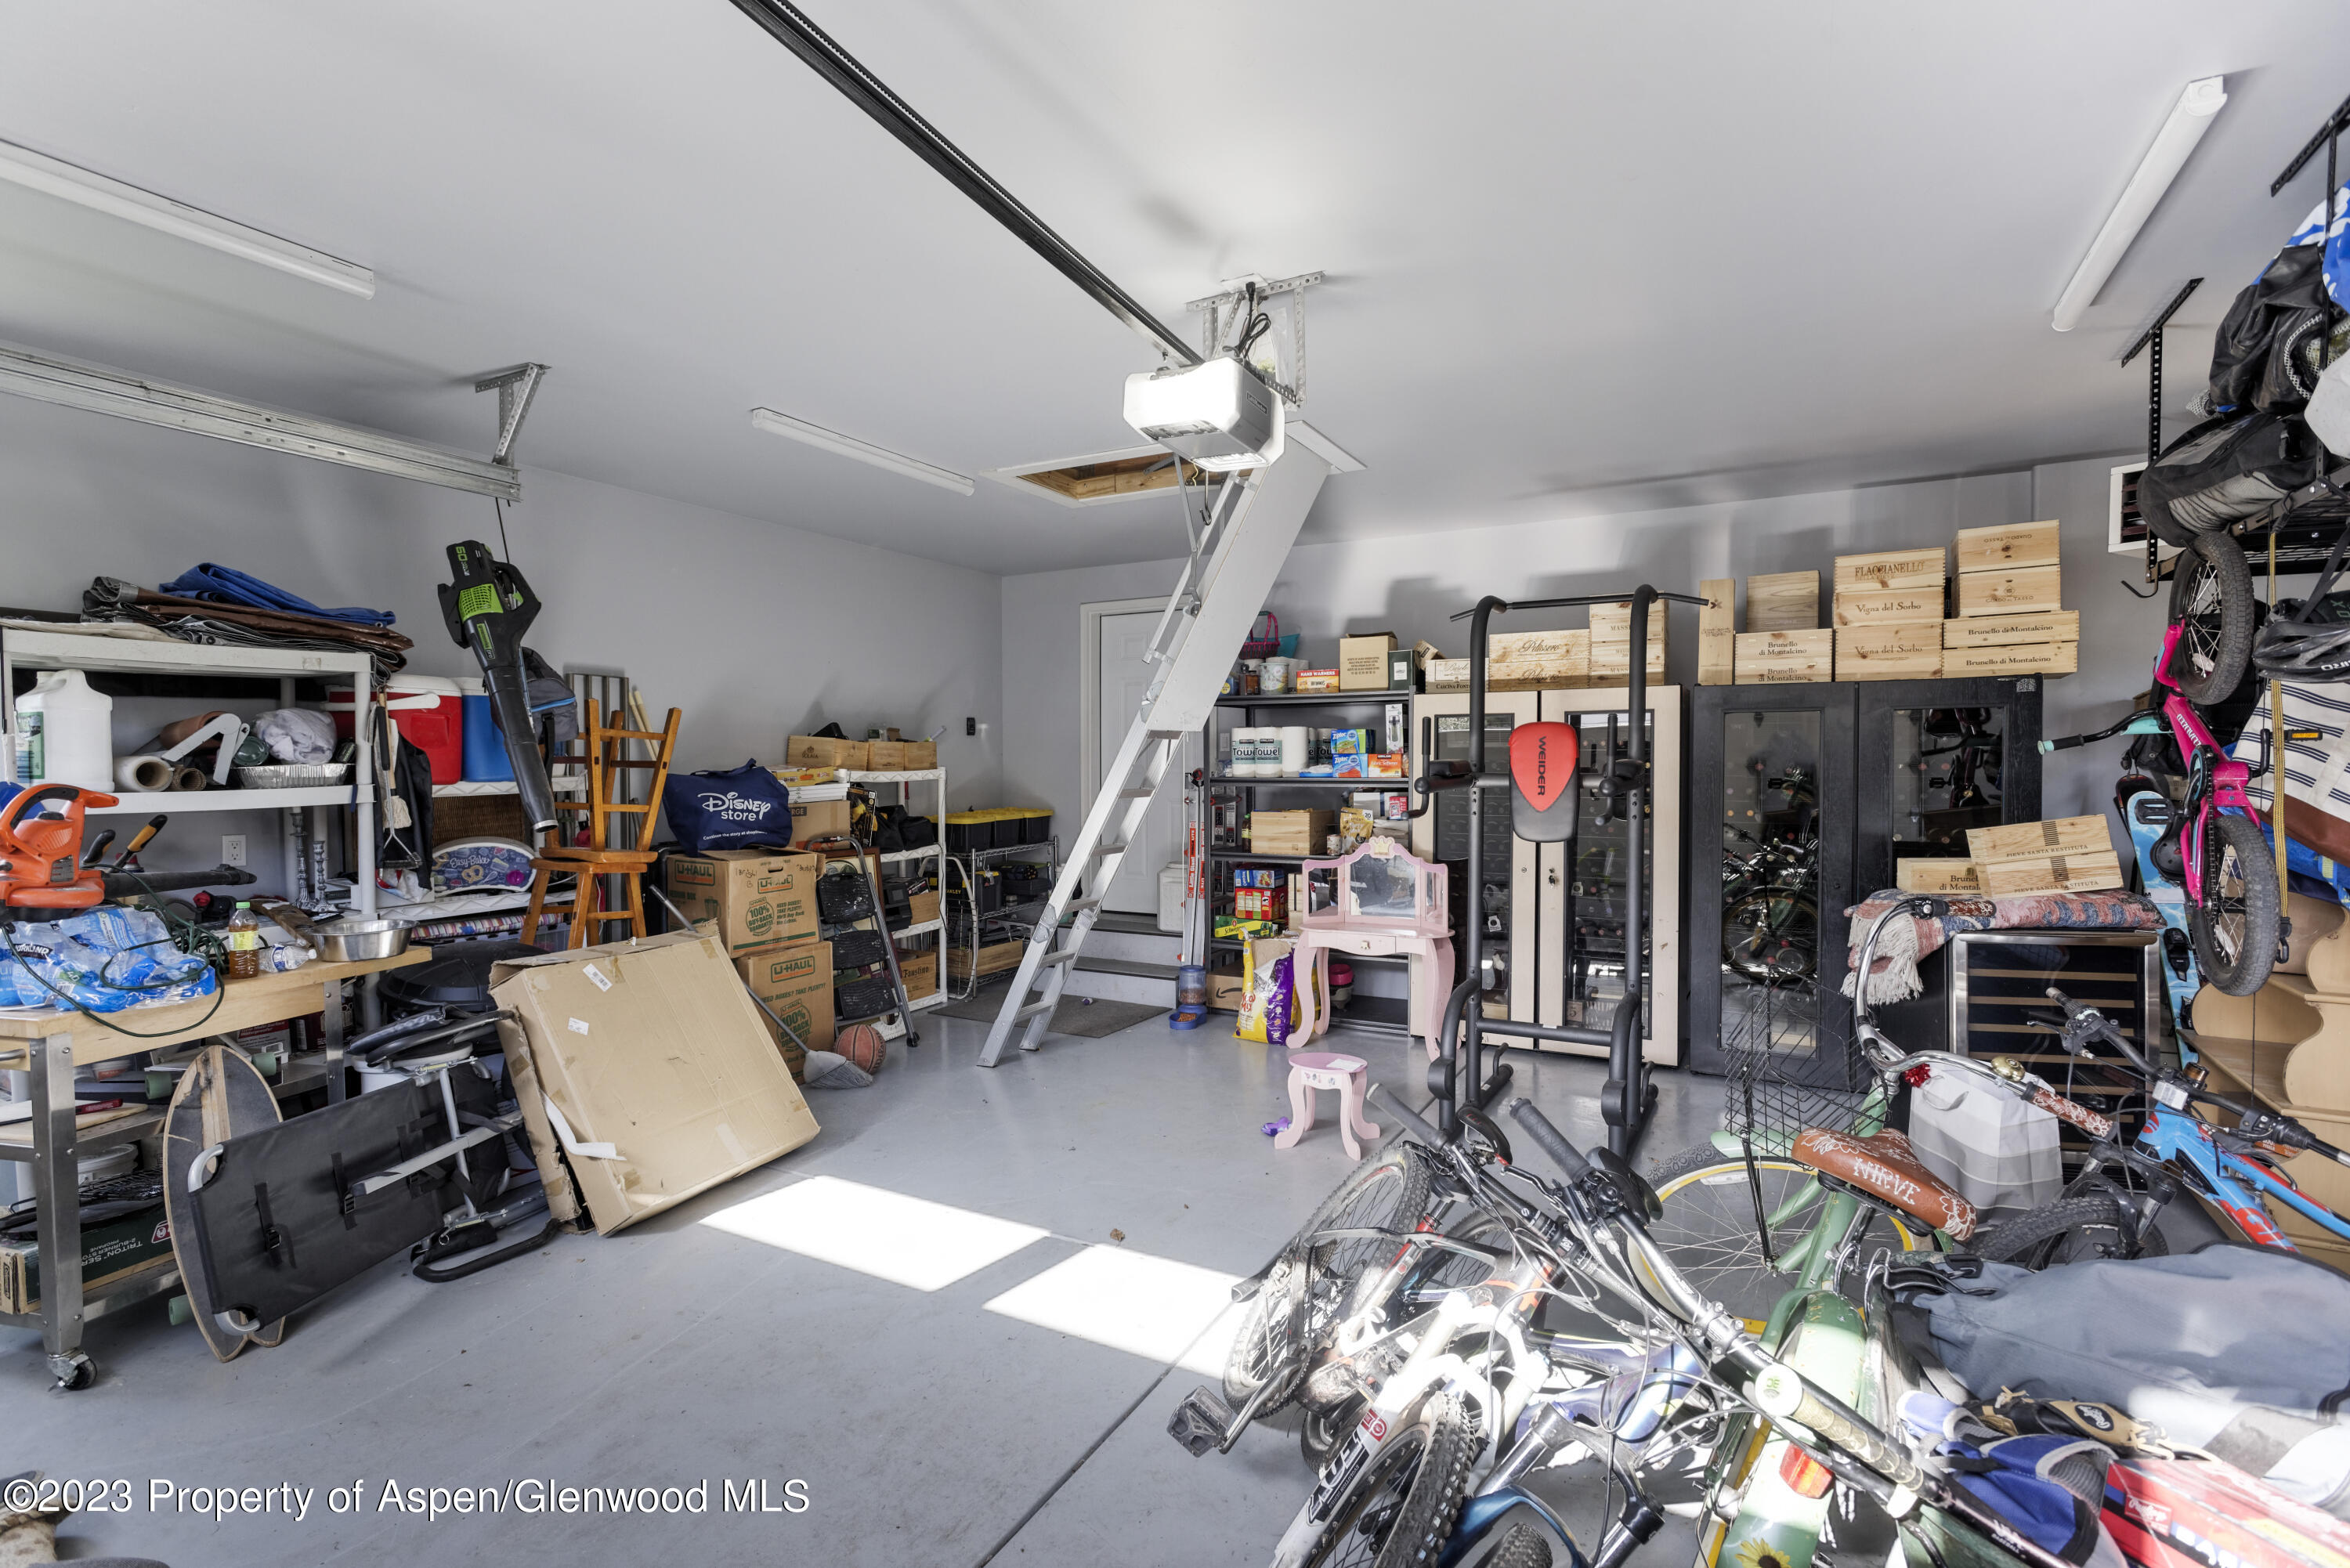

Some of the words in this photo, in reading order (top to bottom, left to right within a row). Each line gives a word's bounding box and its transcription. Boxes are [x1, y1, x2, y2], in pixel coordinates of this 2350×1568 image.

[1855, 562, 1925, 576] FLACCIANELLO
[1855, 604, 1879, 615] Vigna
[1882, 602, 1893, 611] del
[1896, 601, 1922, 610] Sorbo
[1855, 645, 1879, 656] Vigna
[1882, 645, 1893, 654] del
[1897, 644, 1923, 653] Sorbo
[1255, 747, 1280, 756] Towel
[1538, 735, 1546, 796] WEIDER
[697, 792, 771, 820] Disney
[721, 810, 757, 821] store
[2051, 844, 2088, 853] RESTITUTA
[450, 854, 490, 868] Easy-Bake
[677, 864, 713, 877] U-HAUL
[2059, 881, 2099, 890] RESTITUTA
[750, 906, 770, 918] 100%
[748, 914, 772, 927] BUY-BACK
[749, 921, 773, 933] GUARANTEE
[774, 959, 812, 975] U-HAUL
[902, 966, 929, 978] Faustino
[775, 992, 794, 1000] BOXES?
[808, 983, 826, 992] PLENTY!
[1241, 1003, 1253, 1012] MIX
[1853, 1157, 1921, 1205] NIRVE
[89, 1239, 119, 1252] PROPANE
[99, 1237, 136, 1255] 2-BURNER
[108, 1241, 143, 1258] TRITON
[1339, 1464, 1360, 1492] EVOLUTION
[1991, 1533, 2020, 1555] BASEBALL
